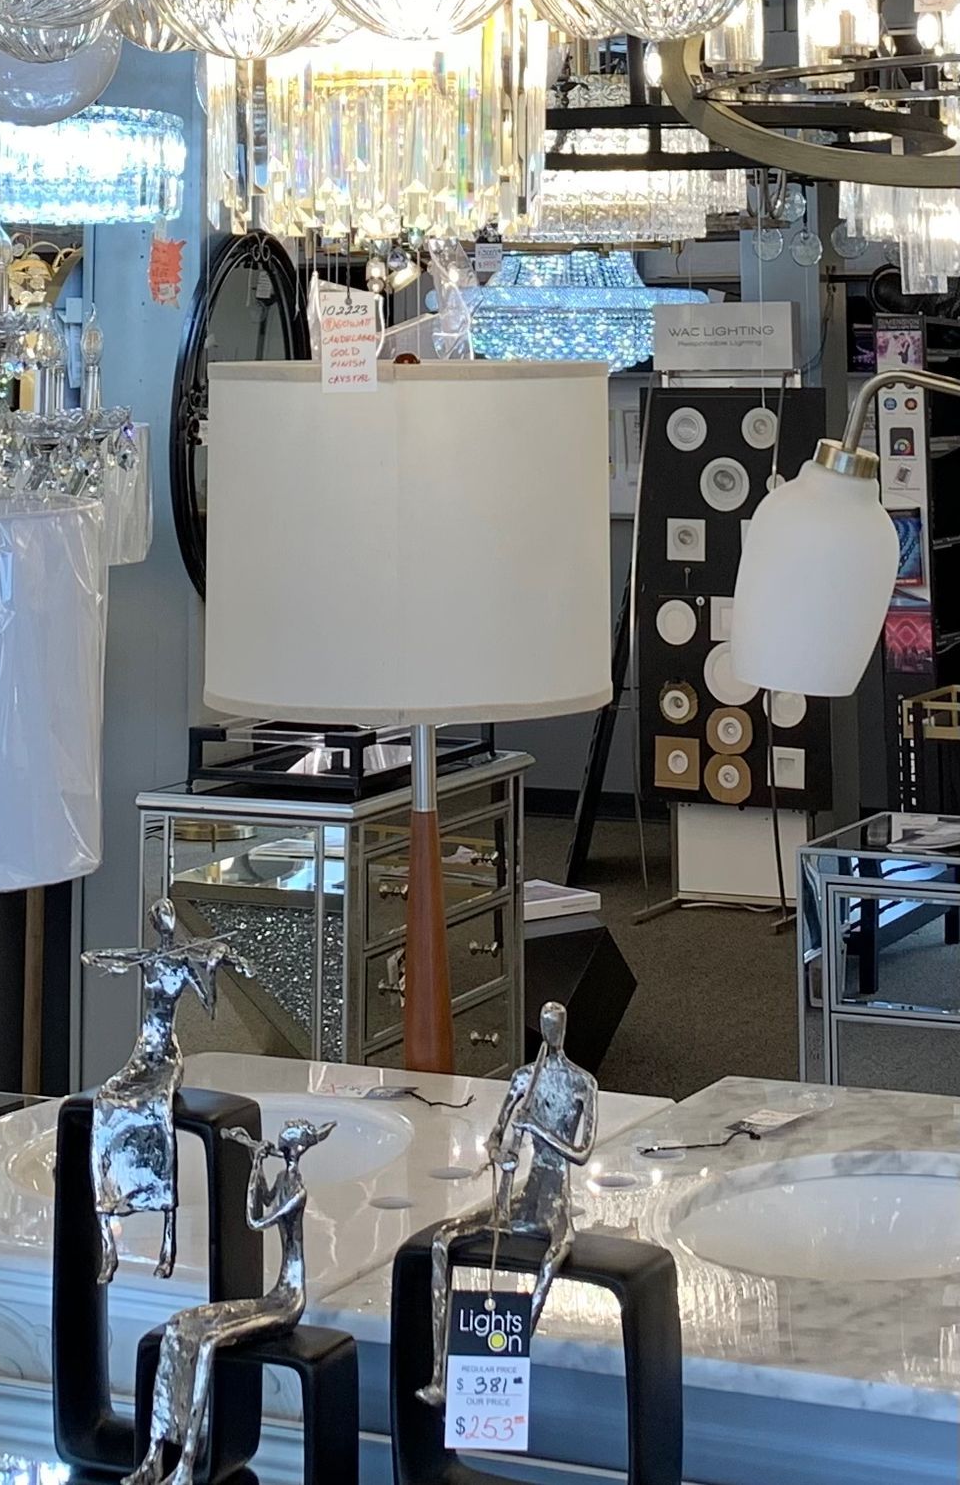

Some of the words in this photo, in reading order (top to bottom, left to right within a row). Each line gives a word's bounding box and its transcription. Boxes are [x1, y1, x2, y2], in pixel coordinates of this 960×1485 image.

[668, 327, 700, 337] WAC
[703, 325, 775, 337] LIGHTING
[330, 347, 360, 357] GOLD
[460, 1309, 522, 1337] Lights
[487, 1329, 522, 1353] On
[461, 1364, 495, 1374] REGULAR
[496, 1365, 518, 1374] PRICE
[466, 1397, 484, 1407] OUR
[486, 1397, 511, 1407] PRICE
